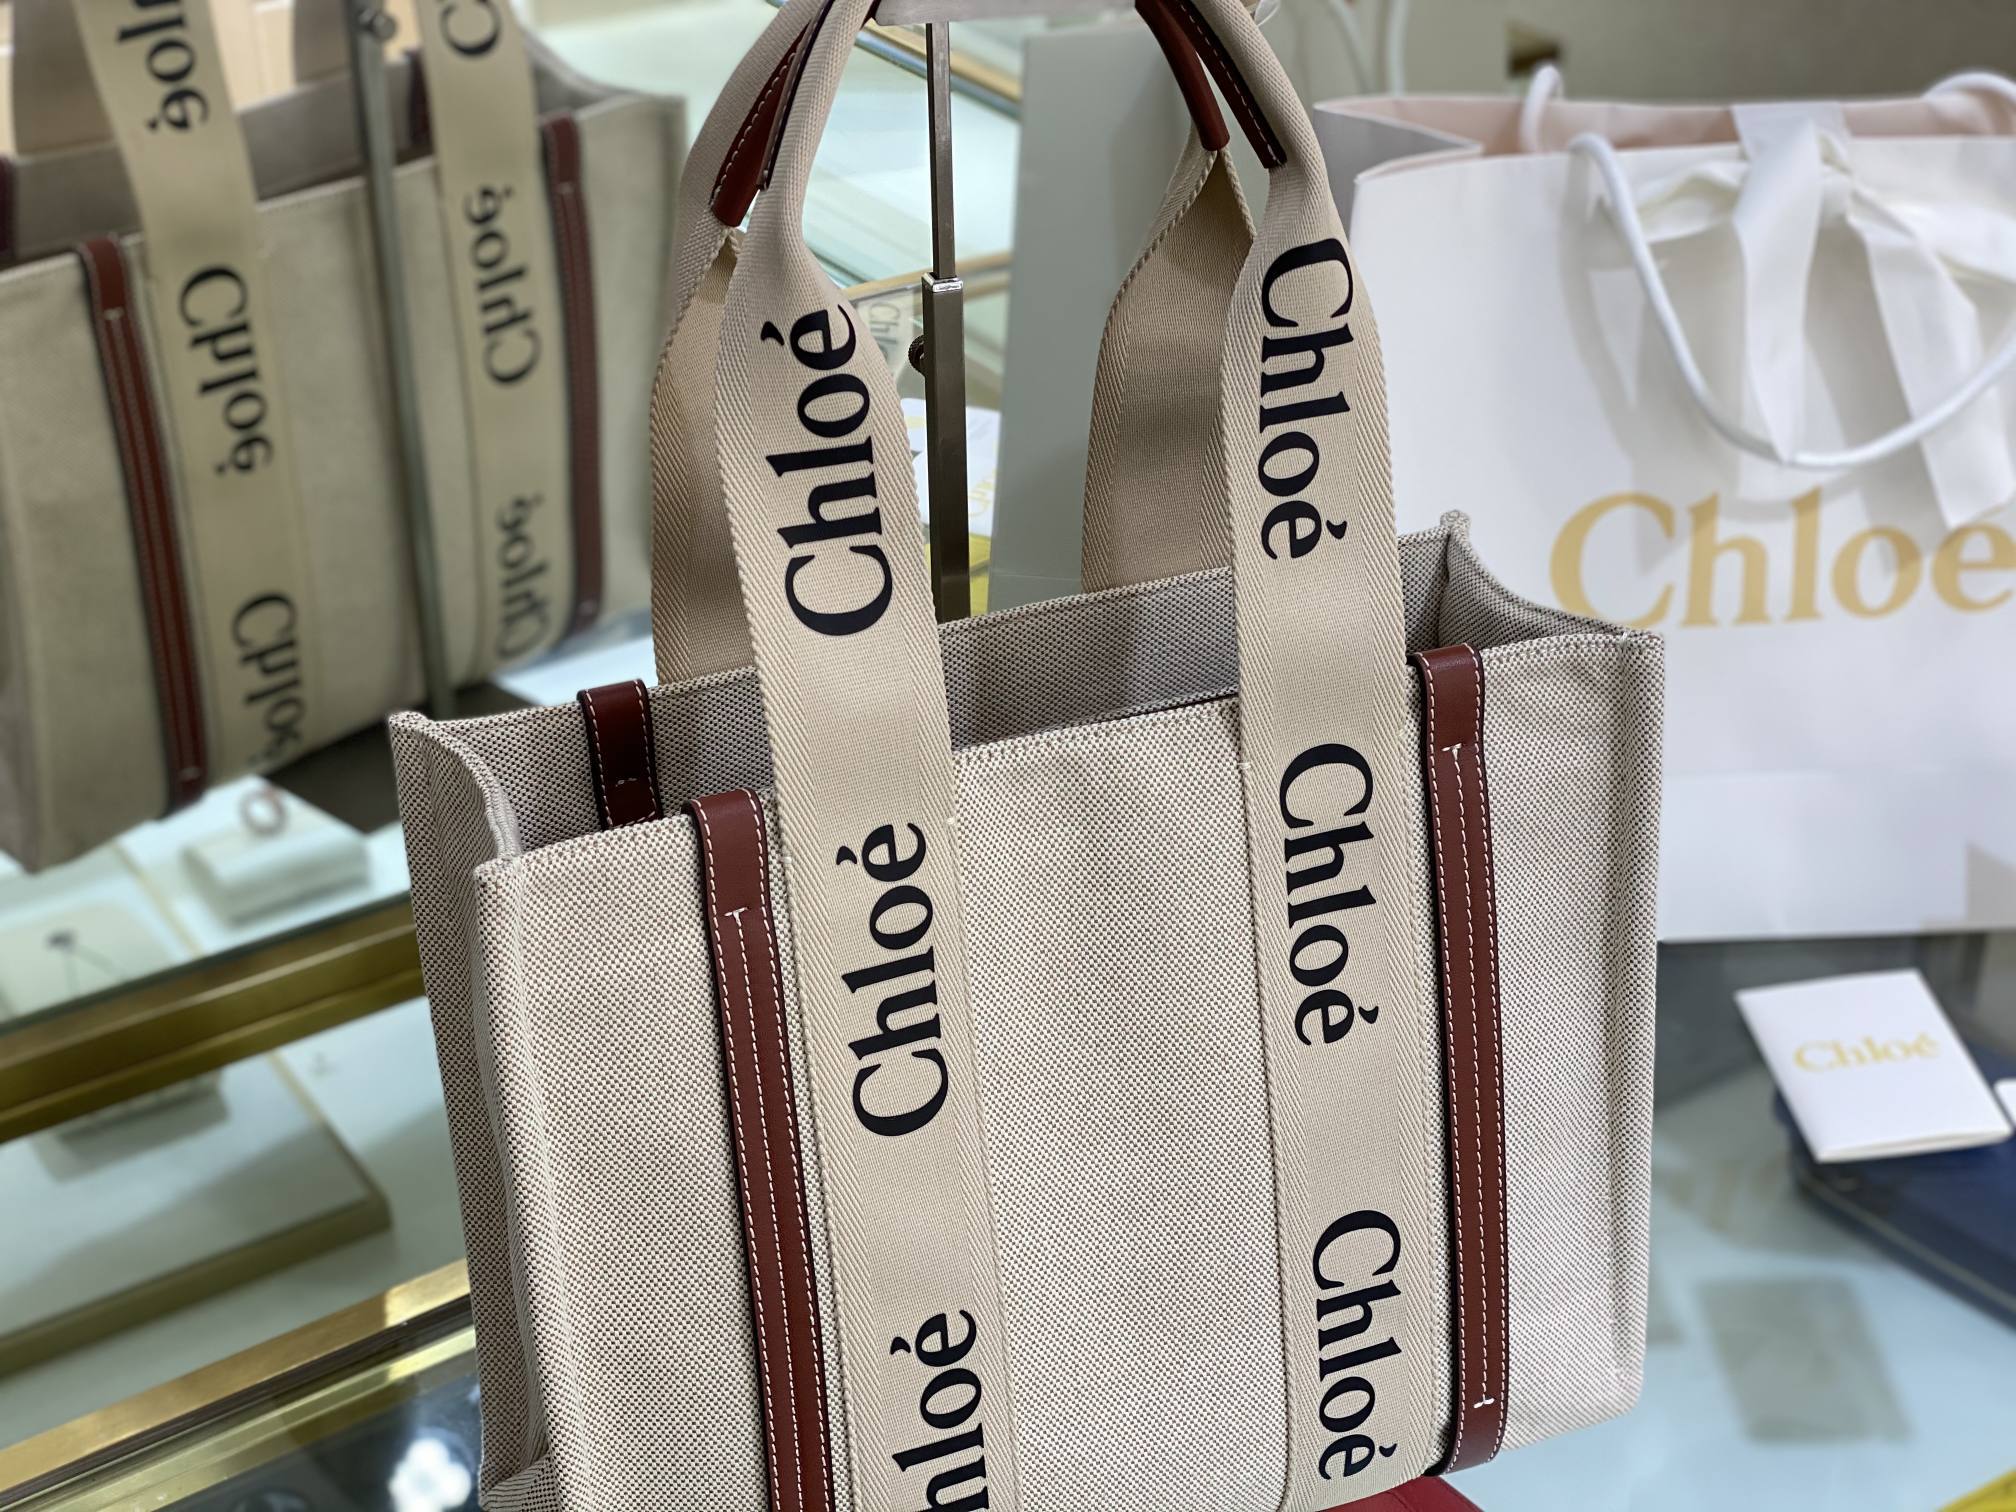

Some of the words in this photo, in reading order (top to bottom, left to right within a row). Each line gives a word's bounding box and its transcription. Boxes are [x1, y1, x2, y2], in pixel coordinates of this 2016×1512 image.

[761, 304, 893, 636] Chloé
[1258, 238, 1354, 559] Chloé
[836, 822, 949, 1137] Chloé
[1279, 743, 1378, 1046] Chloé
[1313, 1209, 1402, 1480] Chloé
